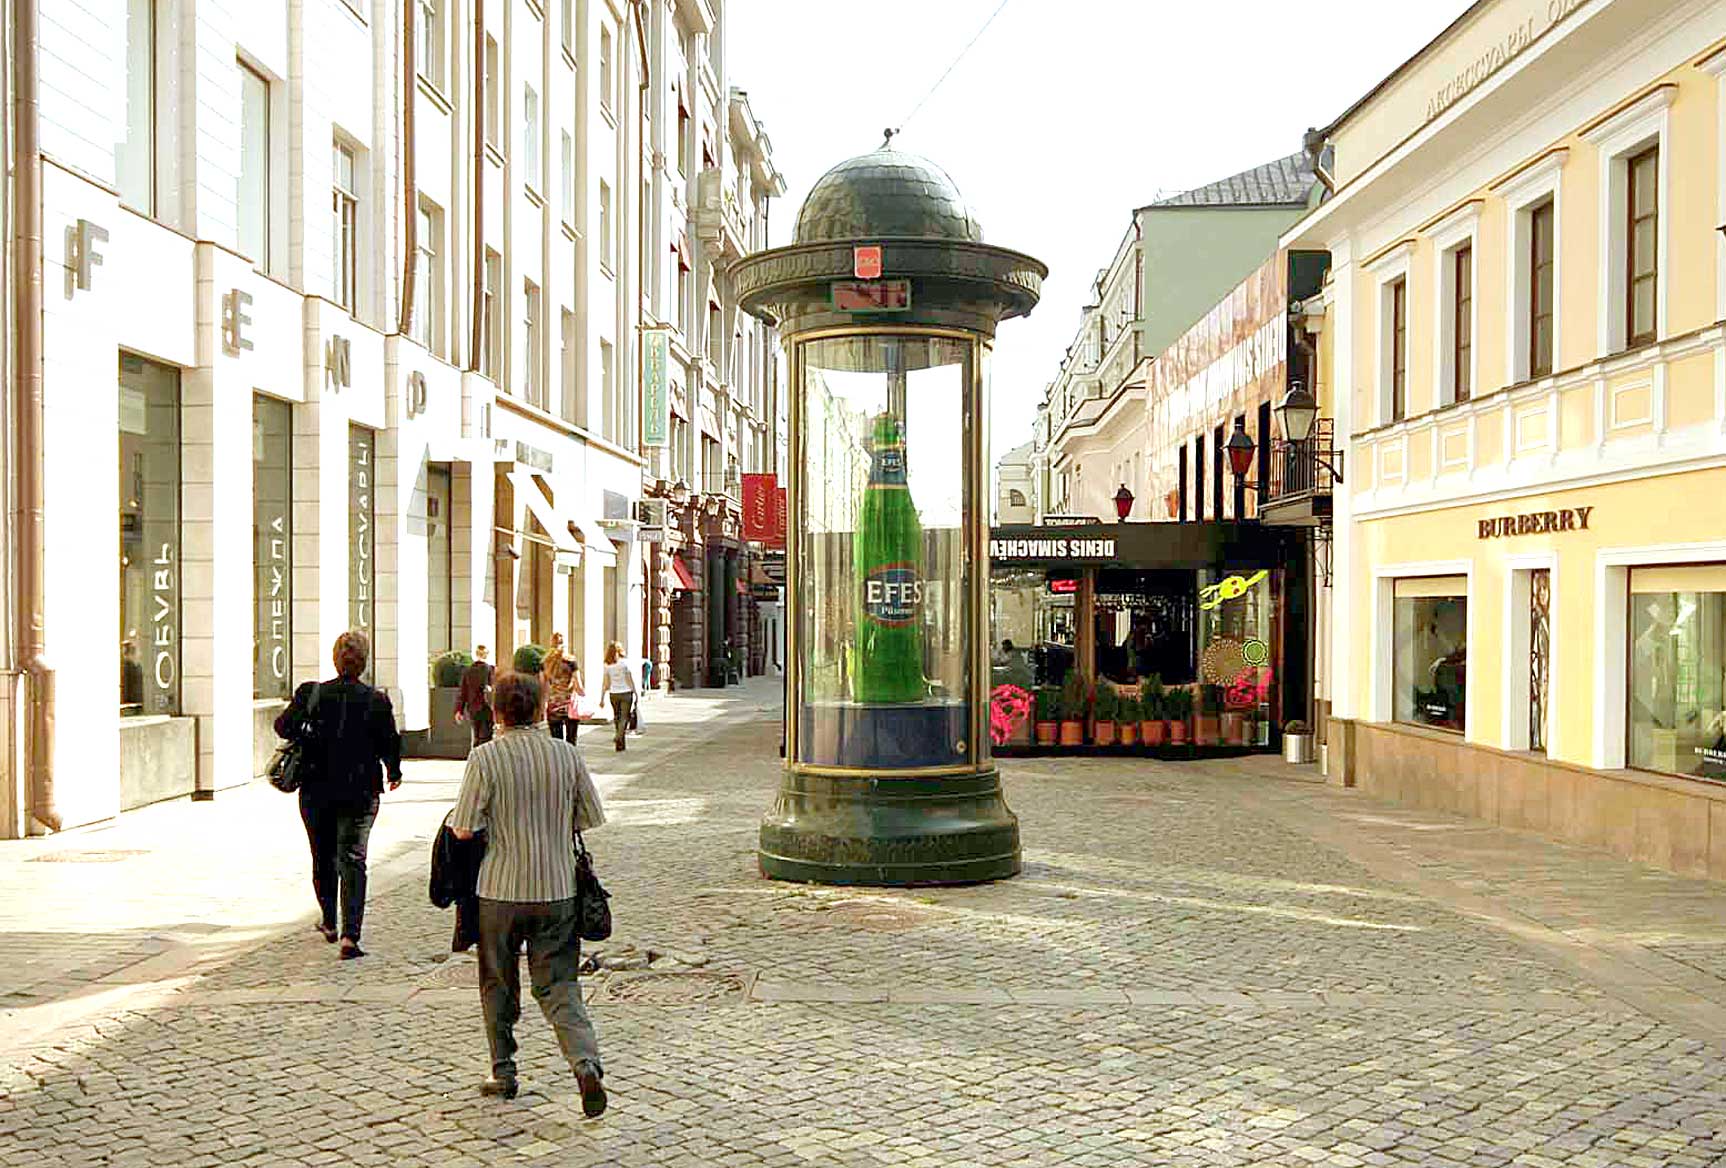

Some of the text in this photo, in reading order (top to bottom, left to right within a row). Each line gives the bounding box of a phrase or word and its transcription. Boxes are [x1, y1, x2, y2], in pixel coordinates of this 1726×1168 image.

[1478, 506, 1594, 540] BURBERRY
[1070, 539, 1115, 557] DENIS
[867, 580, 922, 604] EFES
